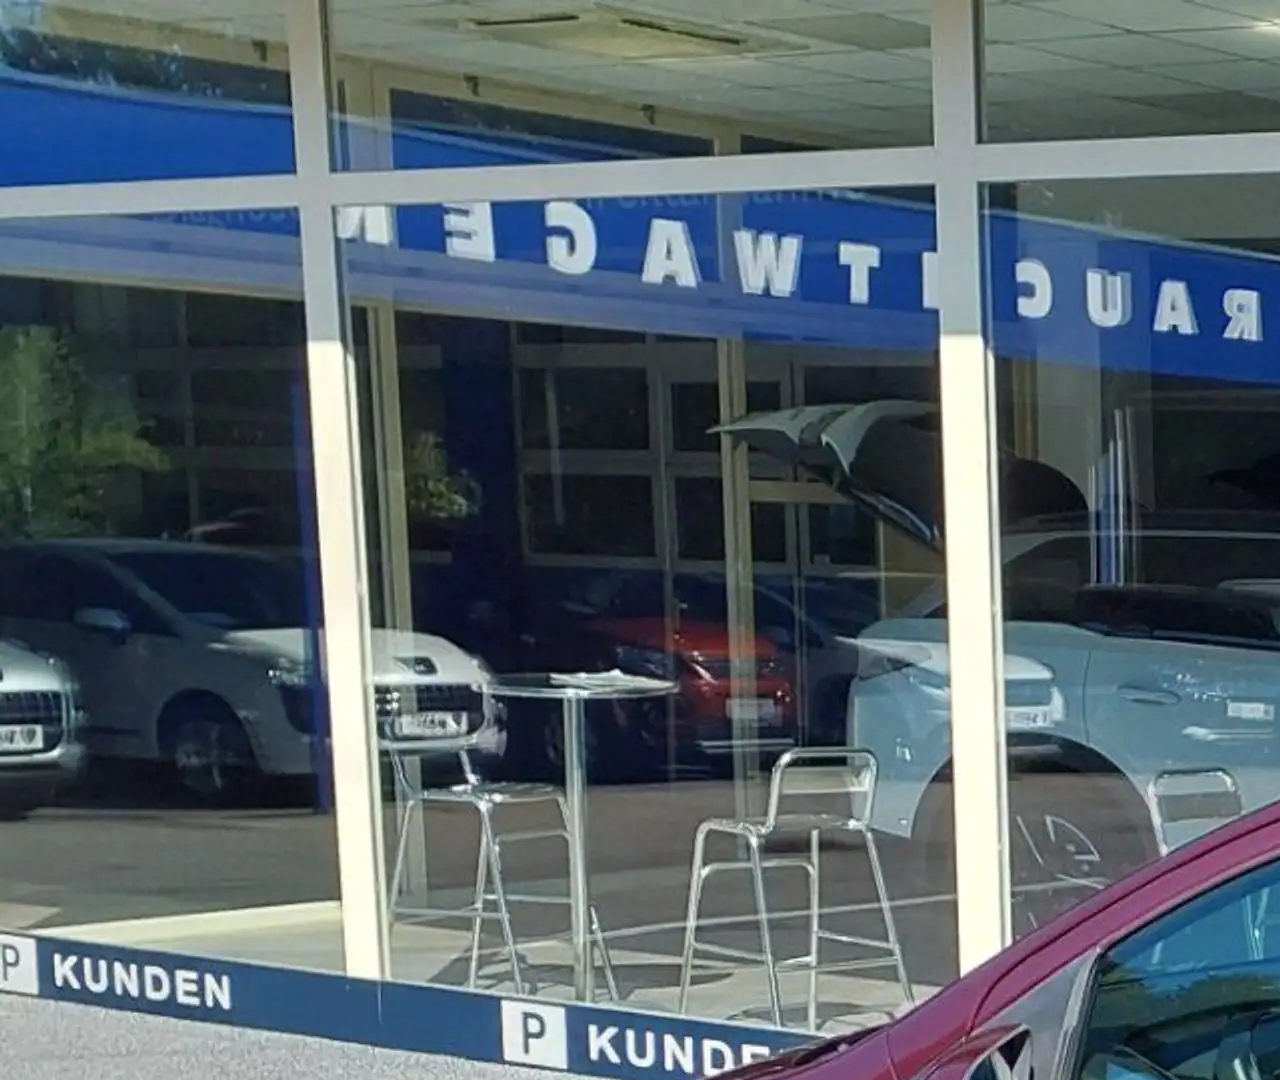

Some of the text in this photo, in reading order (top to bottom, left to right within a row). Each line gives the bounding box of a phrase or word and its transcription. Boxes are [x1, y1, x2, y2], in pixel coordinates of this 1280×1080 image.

[52, 953, 231, 1010] KUNDEN
[523, 1011, 776, 1077] P KUNDE
